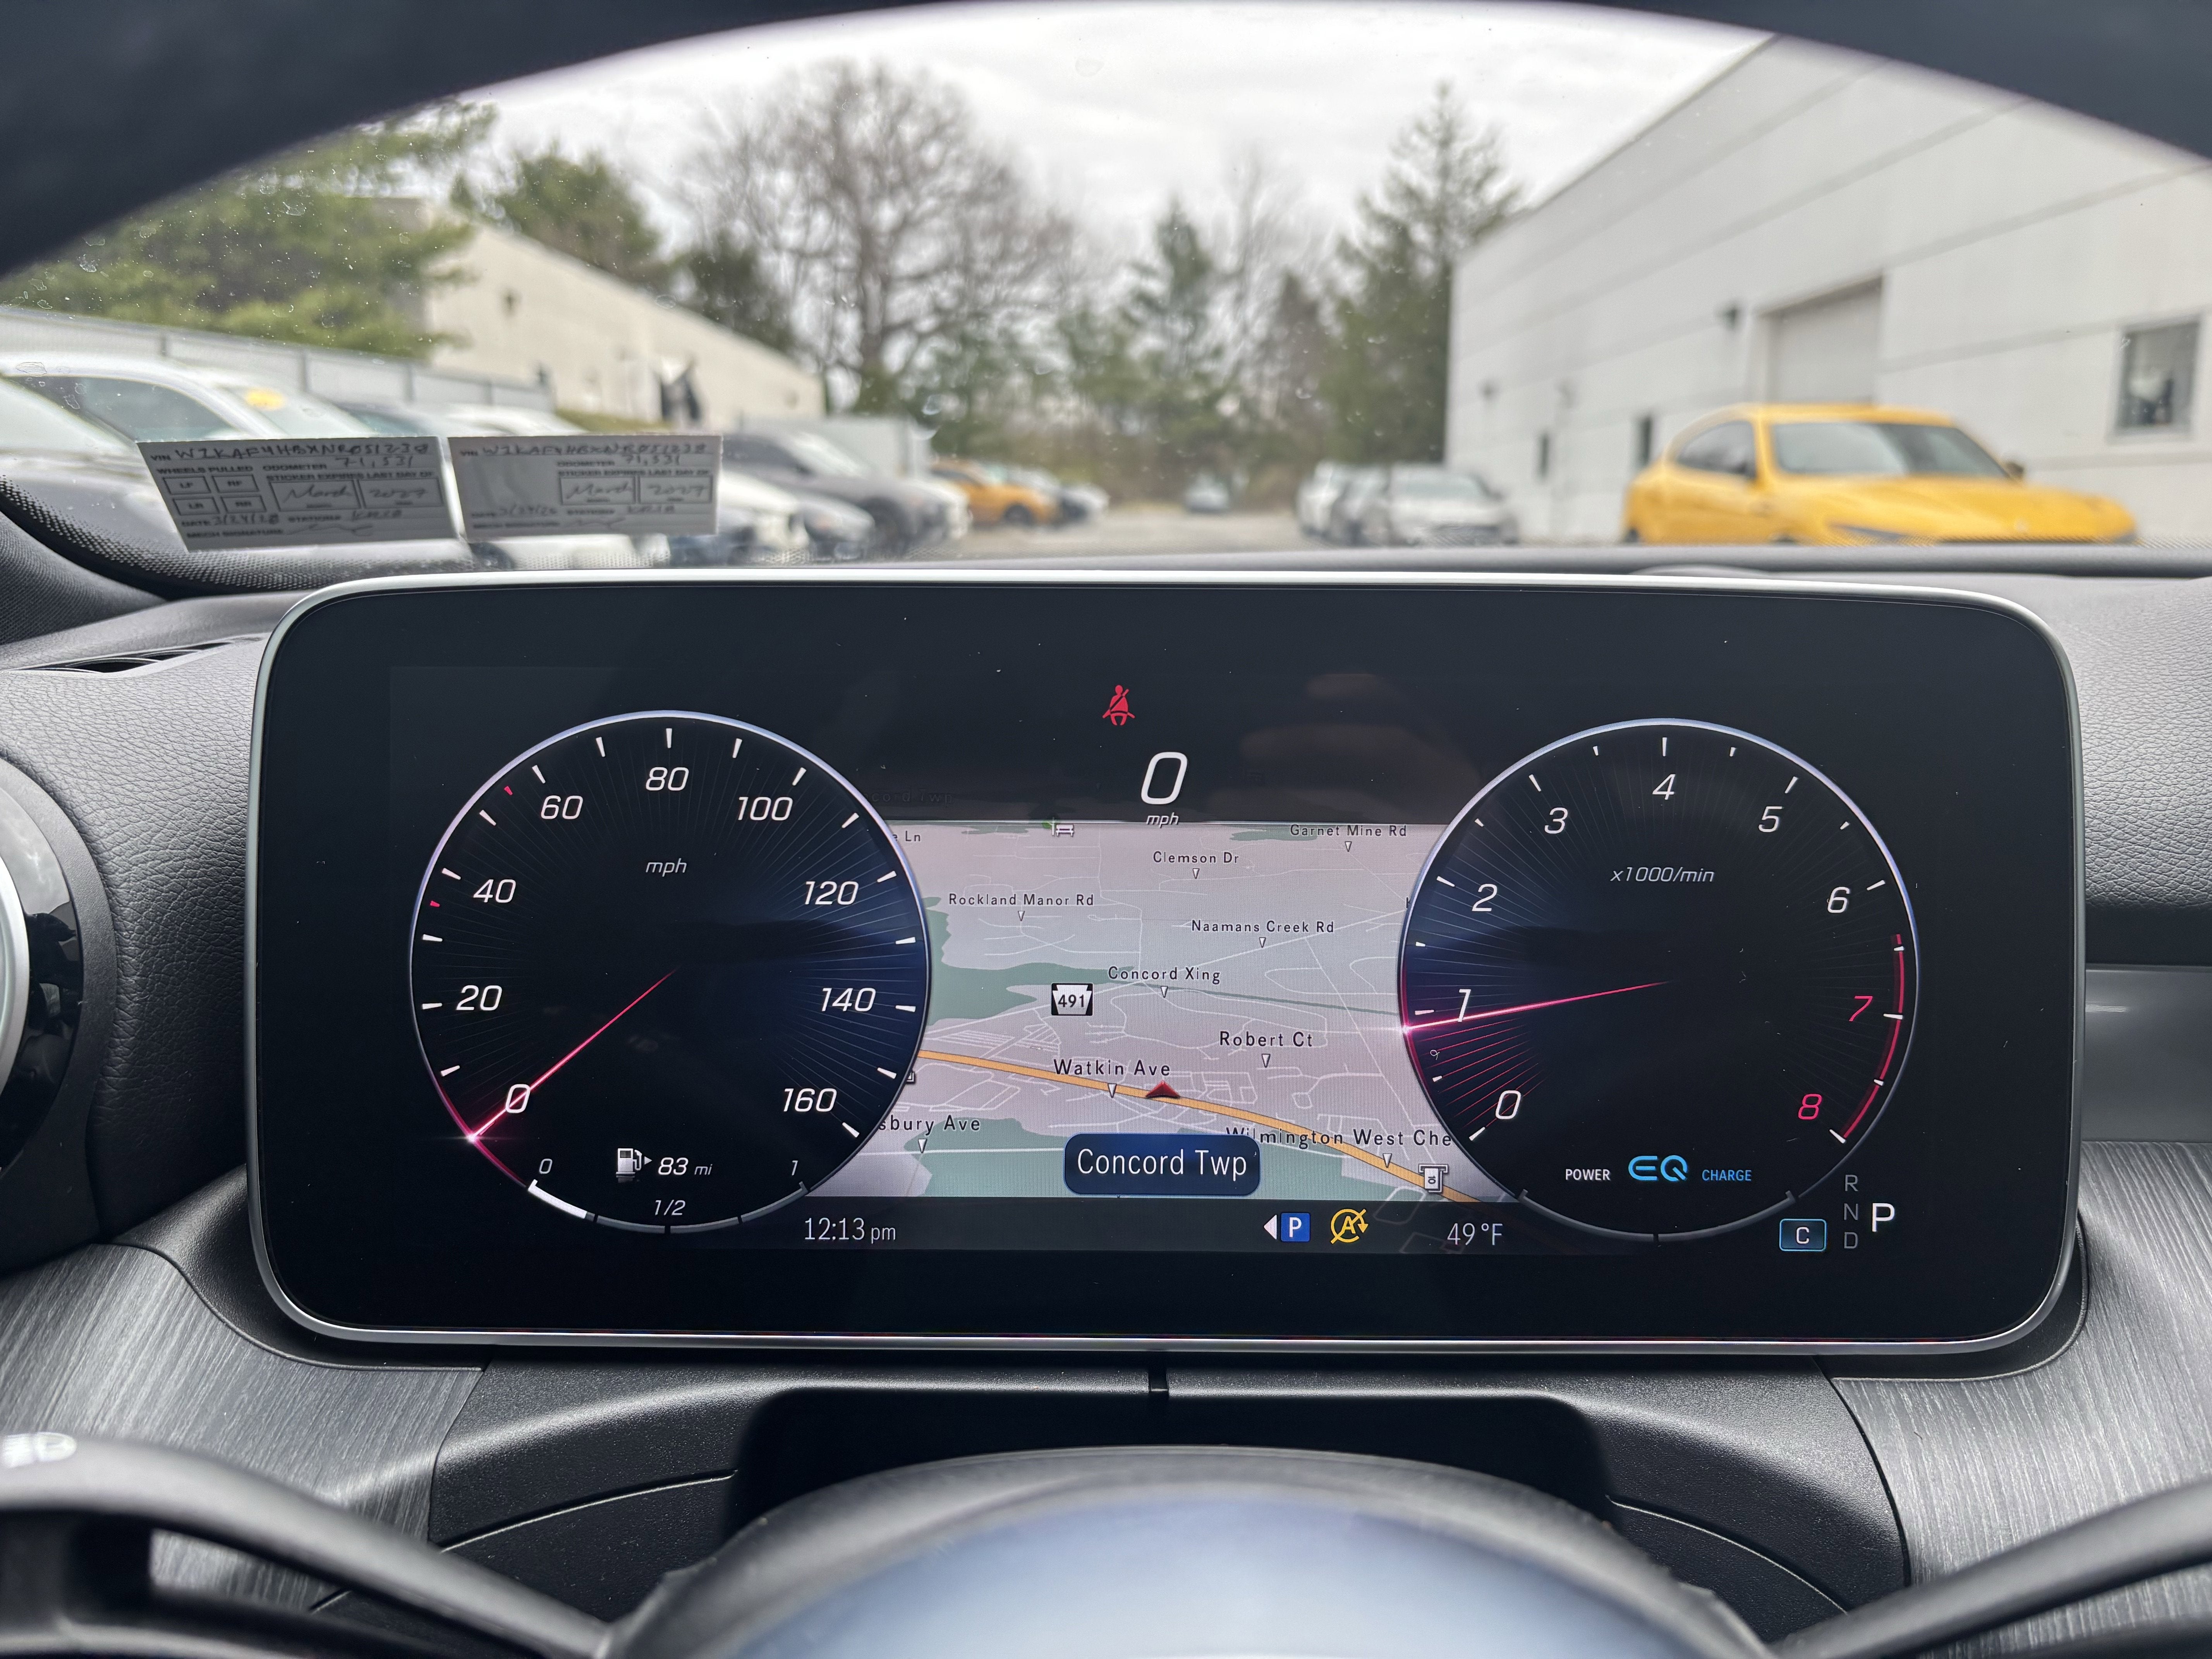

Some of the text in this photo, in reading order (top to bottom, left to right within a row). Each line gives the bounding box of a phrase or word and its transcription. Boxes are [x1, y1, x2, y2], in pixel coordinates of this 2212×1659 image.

[646, 767, 689, 791] 80
[1141, 752, 1187, 805] 0
[1652, 774, 1676, 800] 4
[541, 795, 583, 819] 60
[738, 797, 793, 821] 100
[1146, 812, 1179, 828] mph
[1544, 807, 1568, 834] 3
[1759, 806, 1782, 832] 5
[905, 830, 921, 842] Ln
[1290, 825, 1407, 837] Garnet Mine Rd
[646, 858, 687, 877] mph
[1153, 851, 1239, 864] Clemson Dr
[1610, 867, 1714, 882] x1000/min
[473, 879, 516, 903] 40
[805, 881, 859, 905] 120
[949, 893, 1093, 905] Rockland Manor Rd
[1472, 884, 1498, 912] 2
[1827, 886, 1850, 913] 6
[1192, 920, 1333, 933] Naamans Creek Rd
[1108, 966, 1220, 985] Concord Xing
[456, 985, 502, 1011] 20
[822, 988, 876, 1012] 140
[1058, 994, 1086, 1008] 491
[1458, 989, 1472, 1022] 1
[1849, 996, 1873, 1022] 7
[1220, 1031, 1312, 1047] Robert Ct
[1053, 1059, 1170, 1076] Watkin Ave
[505, 1084, 531, 1113] 0
[783, 1088, 837, 1112] 160
[1495, 1090, 1521, 1119] 0
[1798, 1094, 1822, 1120] 8
[943, 1115, 981, 1131] Ave
[1353, 1129, 1404, 1145] West
[1413, 1129, 1451, 1146] Che
[539, 1158, 553, 1174] 0
[658, 1157, 712, 1175] 83 mi
[792, 1160, 798, 1176] 1
[1078, 1149, 1246, 1182] Concord Twp
[1566, 1169, 1610, 1180] POWER
[1628, 1155, 1688, 1182] EQ
[1702, 1170, 1751, 1181] CHARGE
[1845, 1175, 1858, 1192] R
[655, 1199, 685, 1215] 1/2
[1844, 1203, 1858, 1220] N
[1872, 1203, 1895, 1232] P
[805, 1218, 896, 1244] 12:13 pm
[1289, 1217, 1302, 1238] P
[1447, 1223, 1503, 1245] 49 °F
[1796, 1227, 1809, 1244] C
[1844, 1232, 1858, 1249] D
